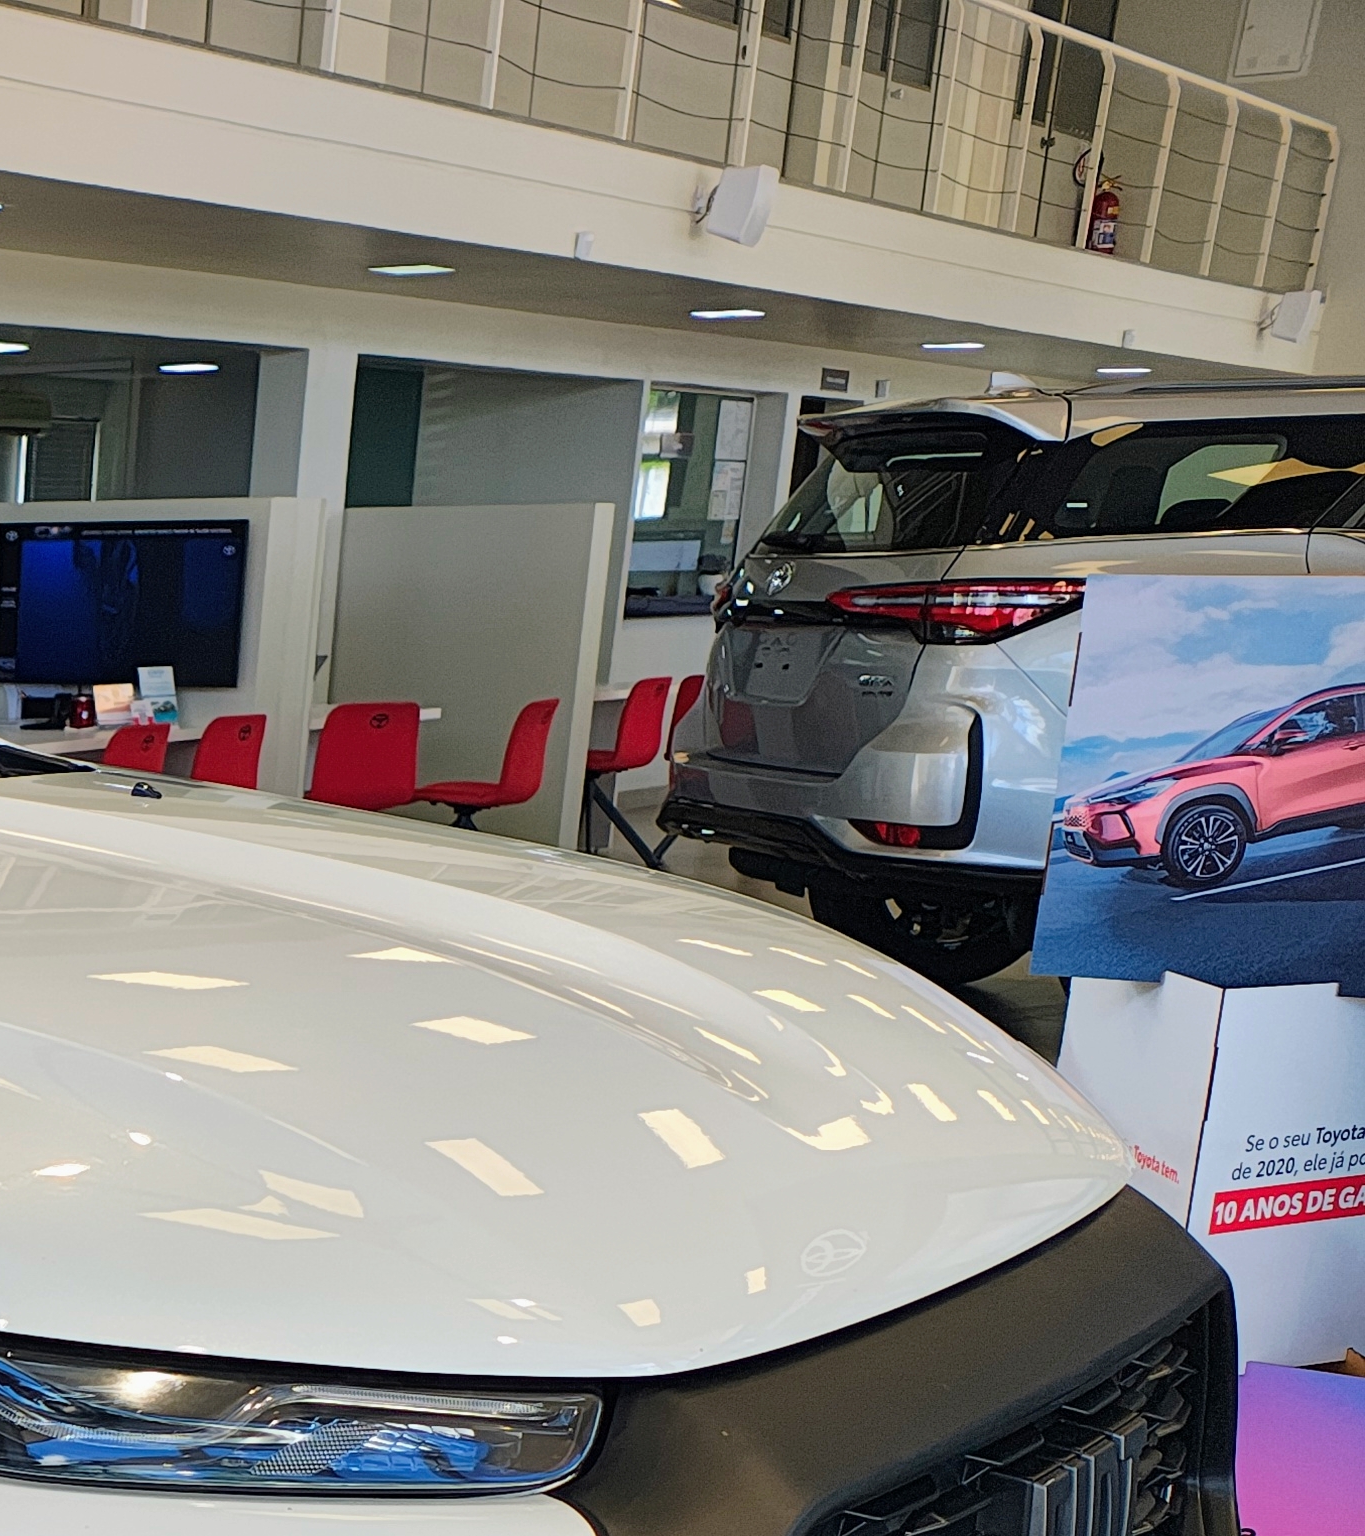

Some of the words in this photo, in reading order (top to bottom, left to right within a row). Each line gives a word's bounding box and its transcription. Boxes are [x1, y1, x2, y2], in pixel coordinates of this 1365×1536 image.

[1245, 1134, 1265, 1153] Se
[1268, 1136, 1279, 1150] o
[1283, 1132, 1311, 1148] seu
[1316, 1124, 1365, 1147] Toyota
[1134, 1144, 1160, 1174] Toyota
[1231, 1162, 1252, 1181] de
[1256, 1156, 1299, 1178] 2020,
[1303, 1153, 1328, 1172] ele
[1329, 1150, 1345, 1174] já
[1215, 1200, 1238, 1226] 10
[1239, 1192, 1305, 1223] ANOS
[1306, 1187, 1337, 1214] DE
